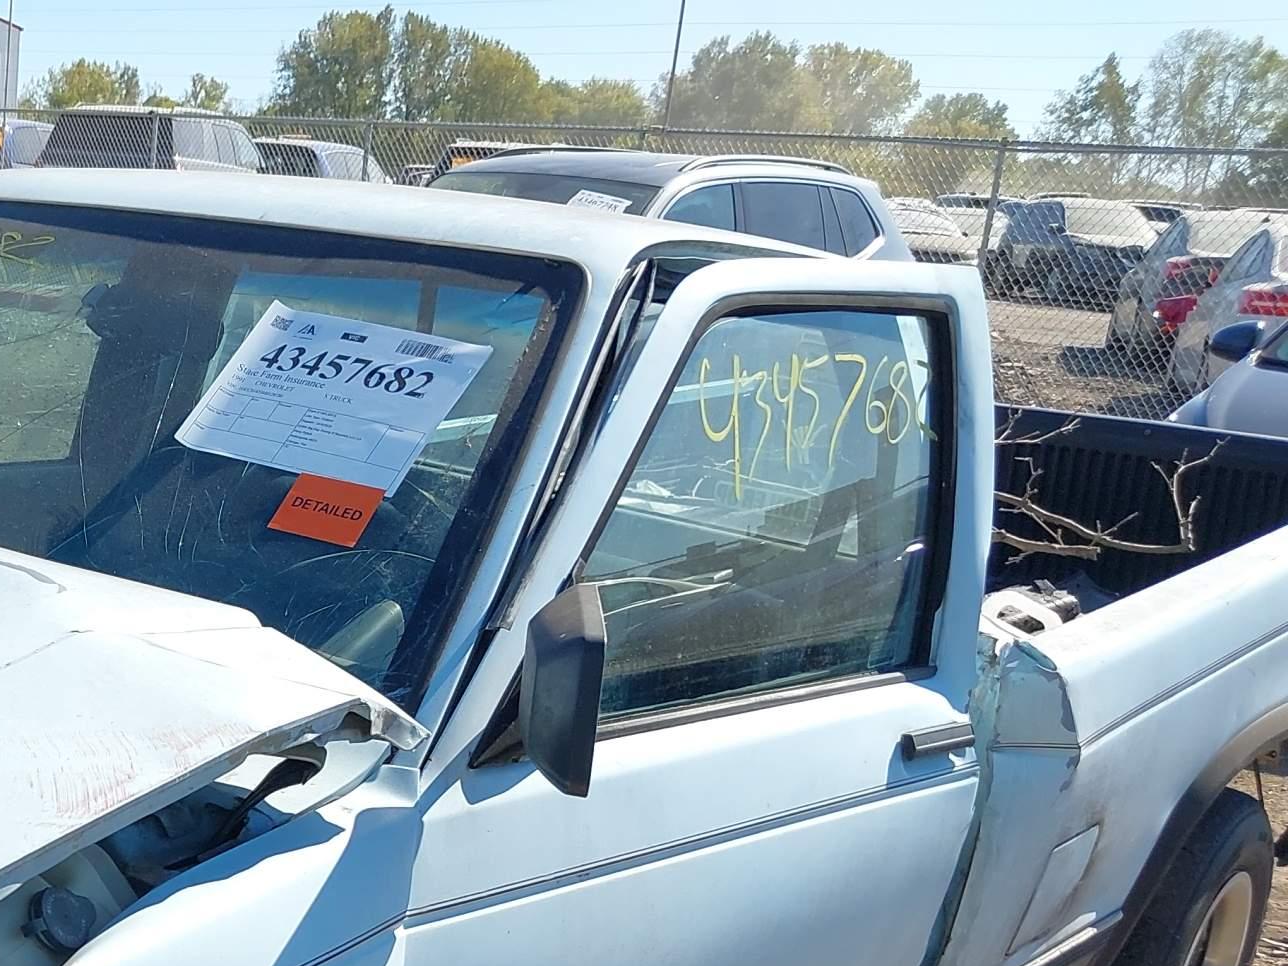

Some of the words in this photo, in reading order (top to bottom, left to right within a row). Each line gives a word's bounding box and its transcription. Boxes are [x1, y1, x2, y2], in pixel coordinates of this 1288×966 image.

[237, 363, 258, 377] State
[259, 370, 281, 381] Farm
[286, 374, 326, 389] Insurance
[260, 343, 435, 399] 43457682
[698, 352, 938, 500] 43457682
[290, 495, 363, 522] DETAILED
